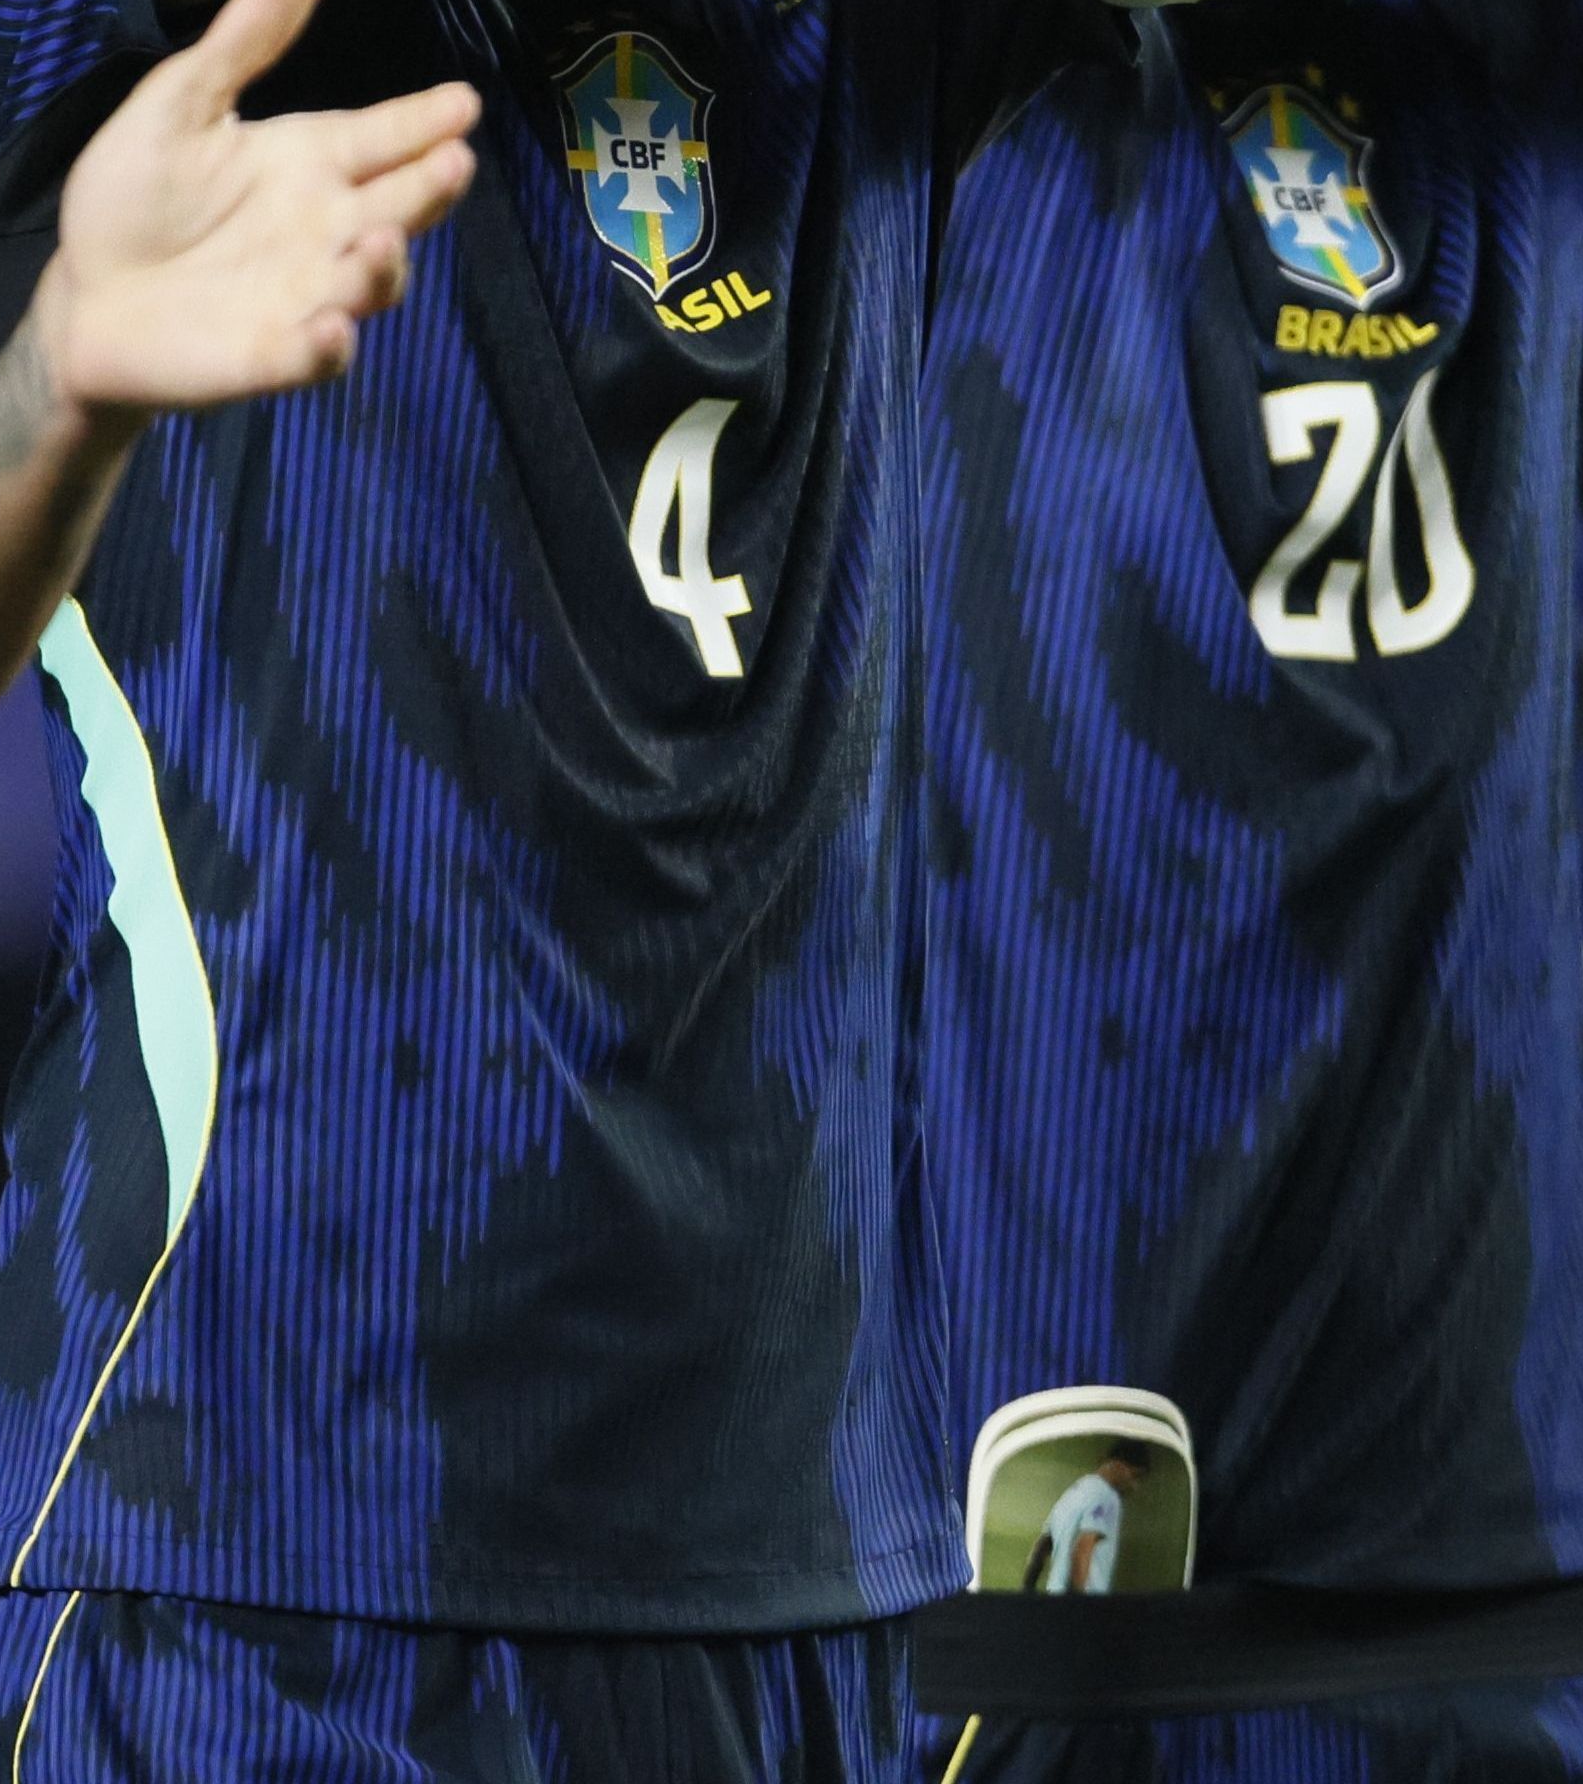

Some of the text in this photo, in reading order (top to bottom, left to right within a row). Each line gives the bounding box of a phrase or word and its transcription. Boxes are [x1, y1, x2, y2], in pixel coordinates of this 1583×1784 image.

[610, 138, 666, 172] CBF
[1273, 185, 1327, 213] CBF
[654, 271, 772, 334] ASIL
[1274, 304, 1440, 360] BRASIL
[627, 397, 753, 678] 4
[1249, 365, 1477, 662] 20
